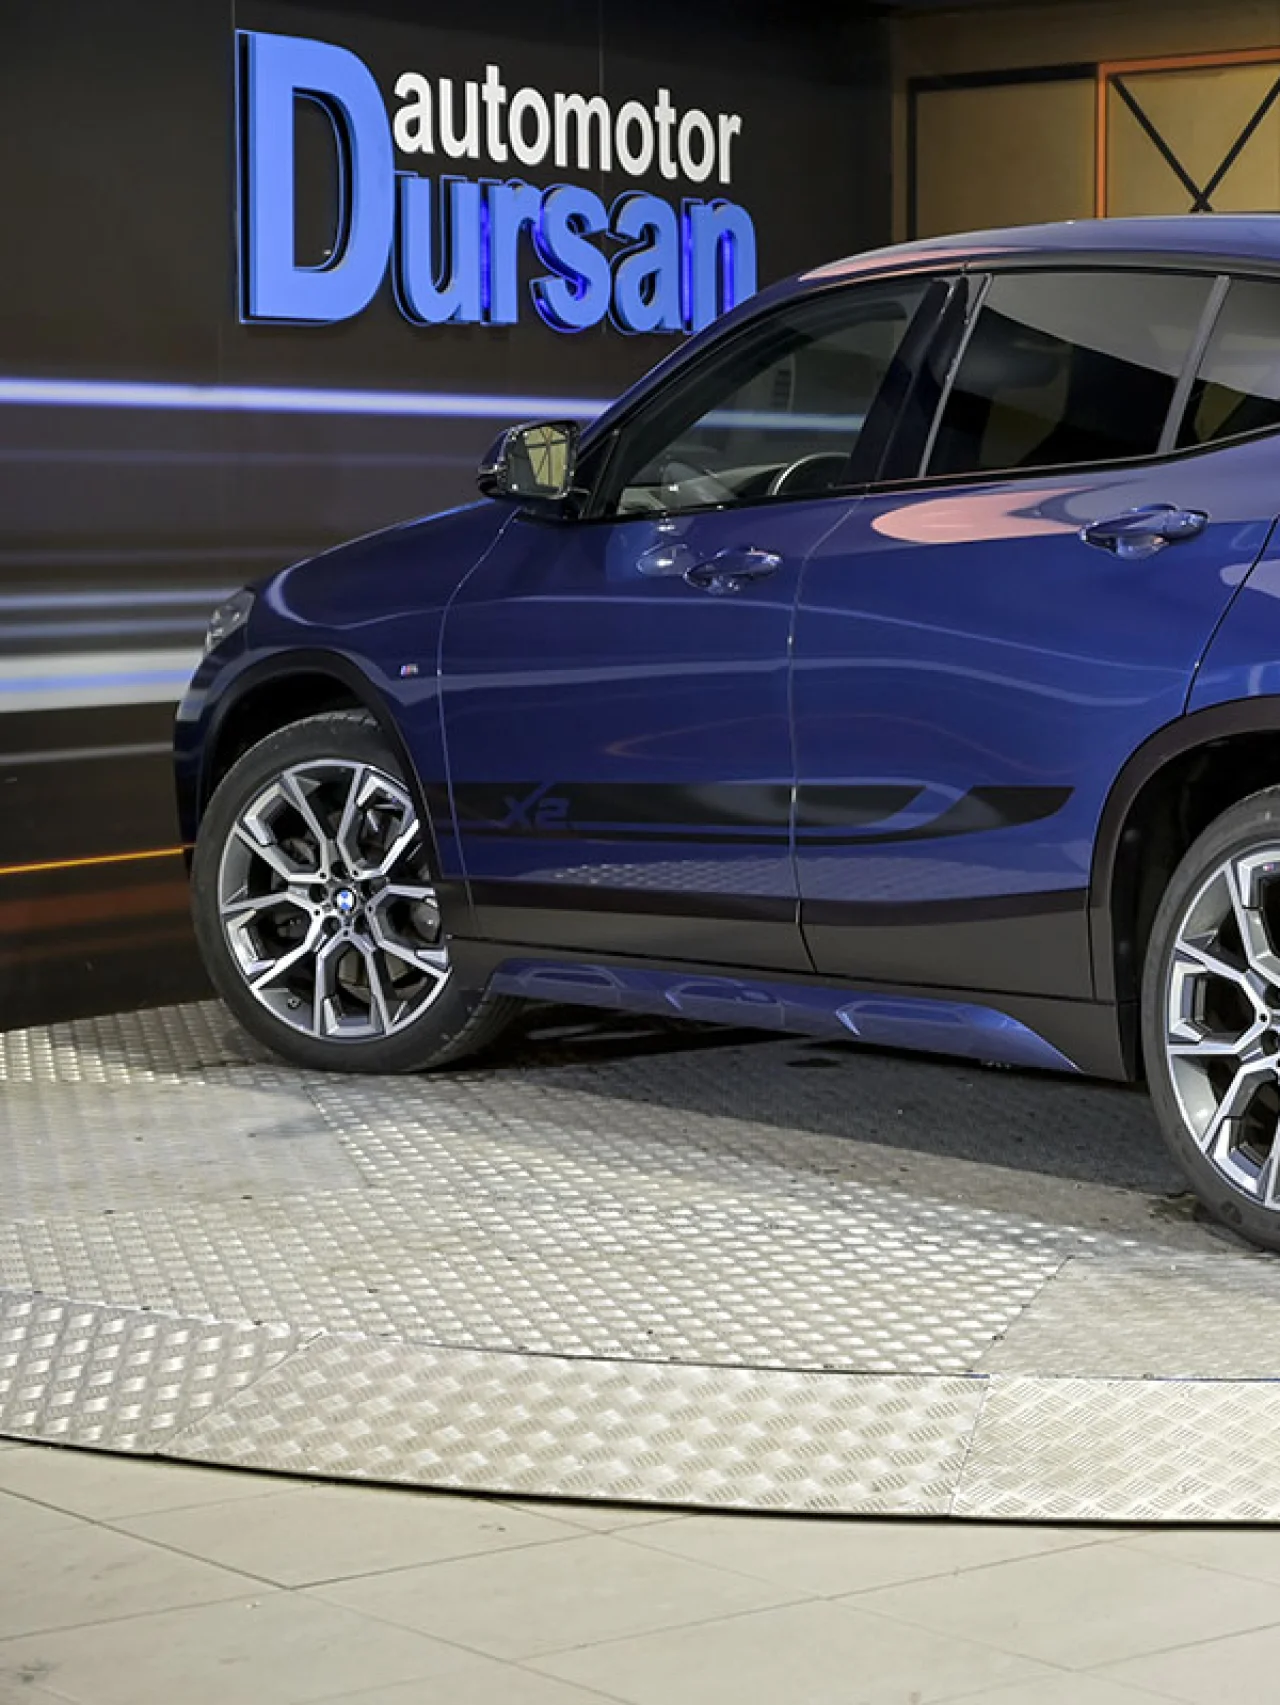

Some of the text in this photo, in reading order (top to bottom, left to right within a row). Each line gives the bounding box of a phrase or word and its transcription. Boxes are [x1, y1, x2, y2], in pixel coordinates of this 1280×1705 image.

[235, 30, 757, 335] Dursan
[394, 64, 742, 184] automotor
[502, 780, 570, 832] X2
